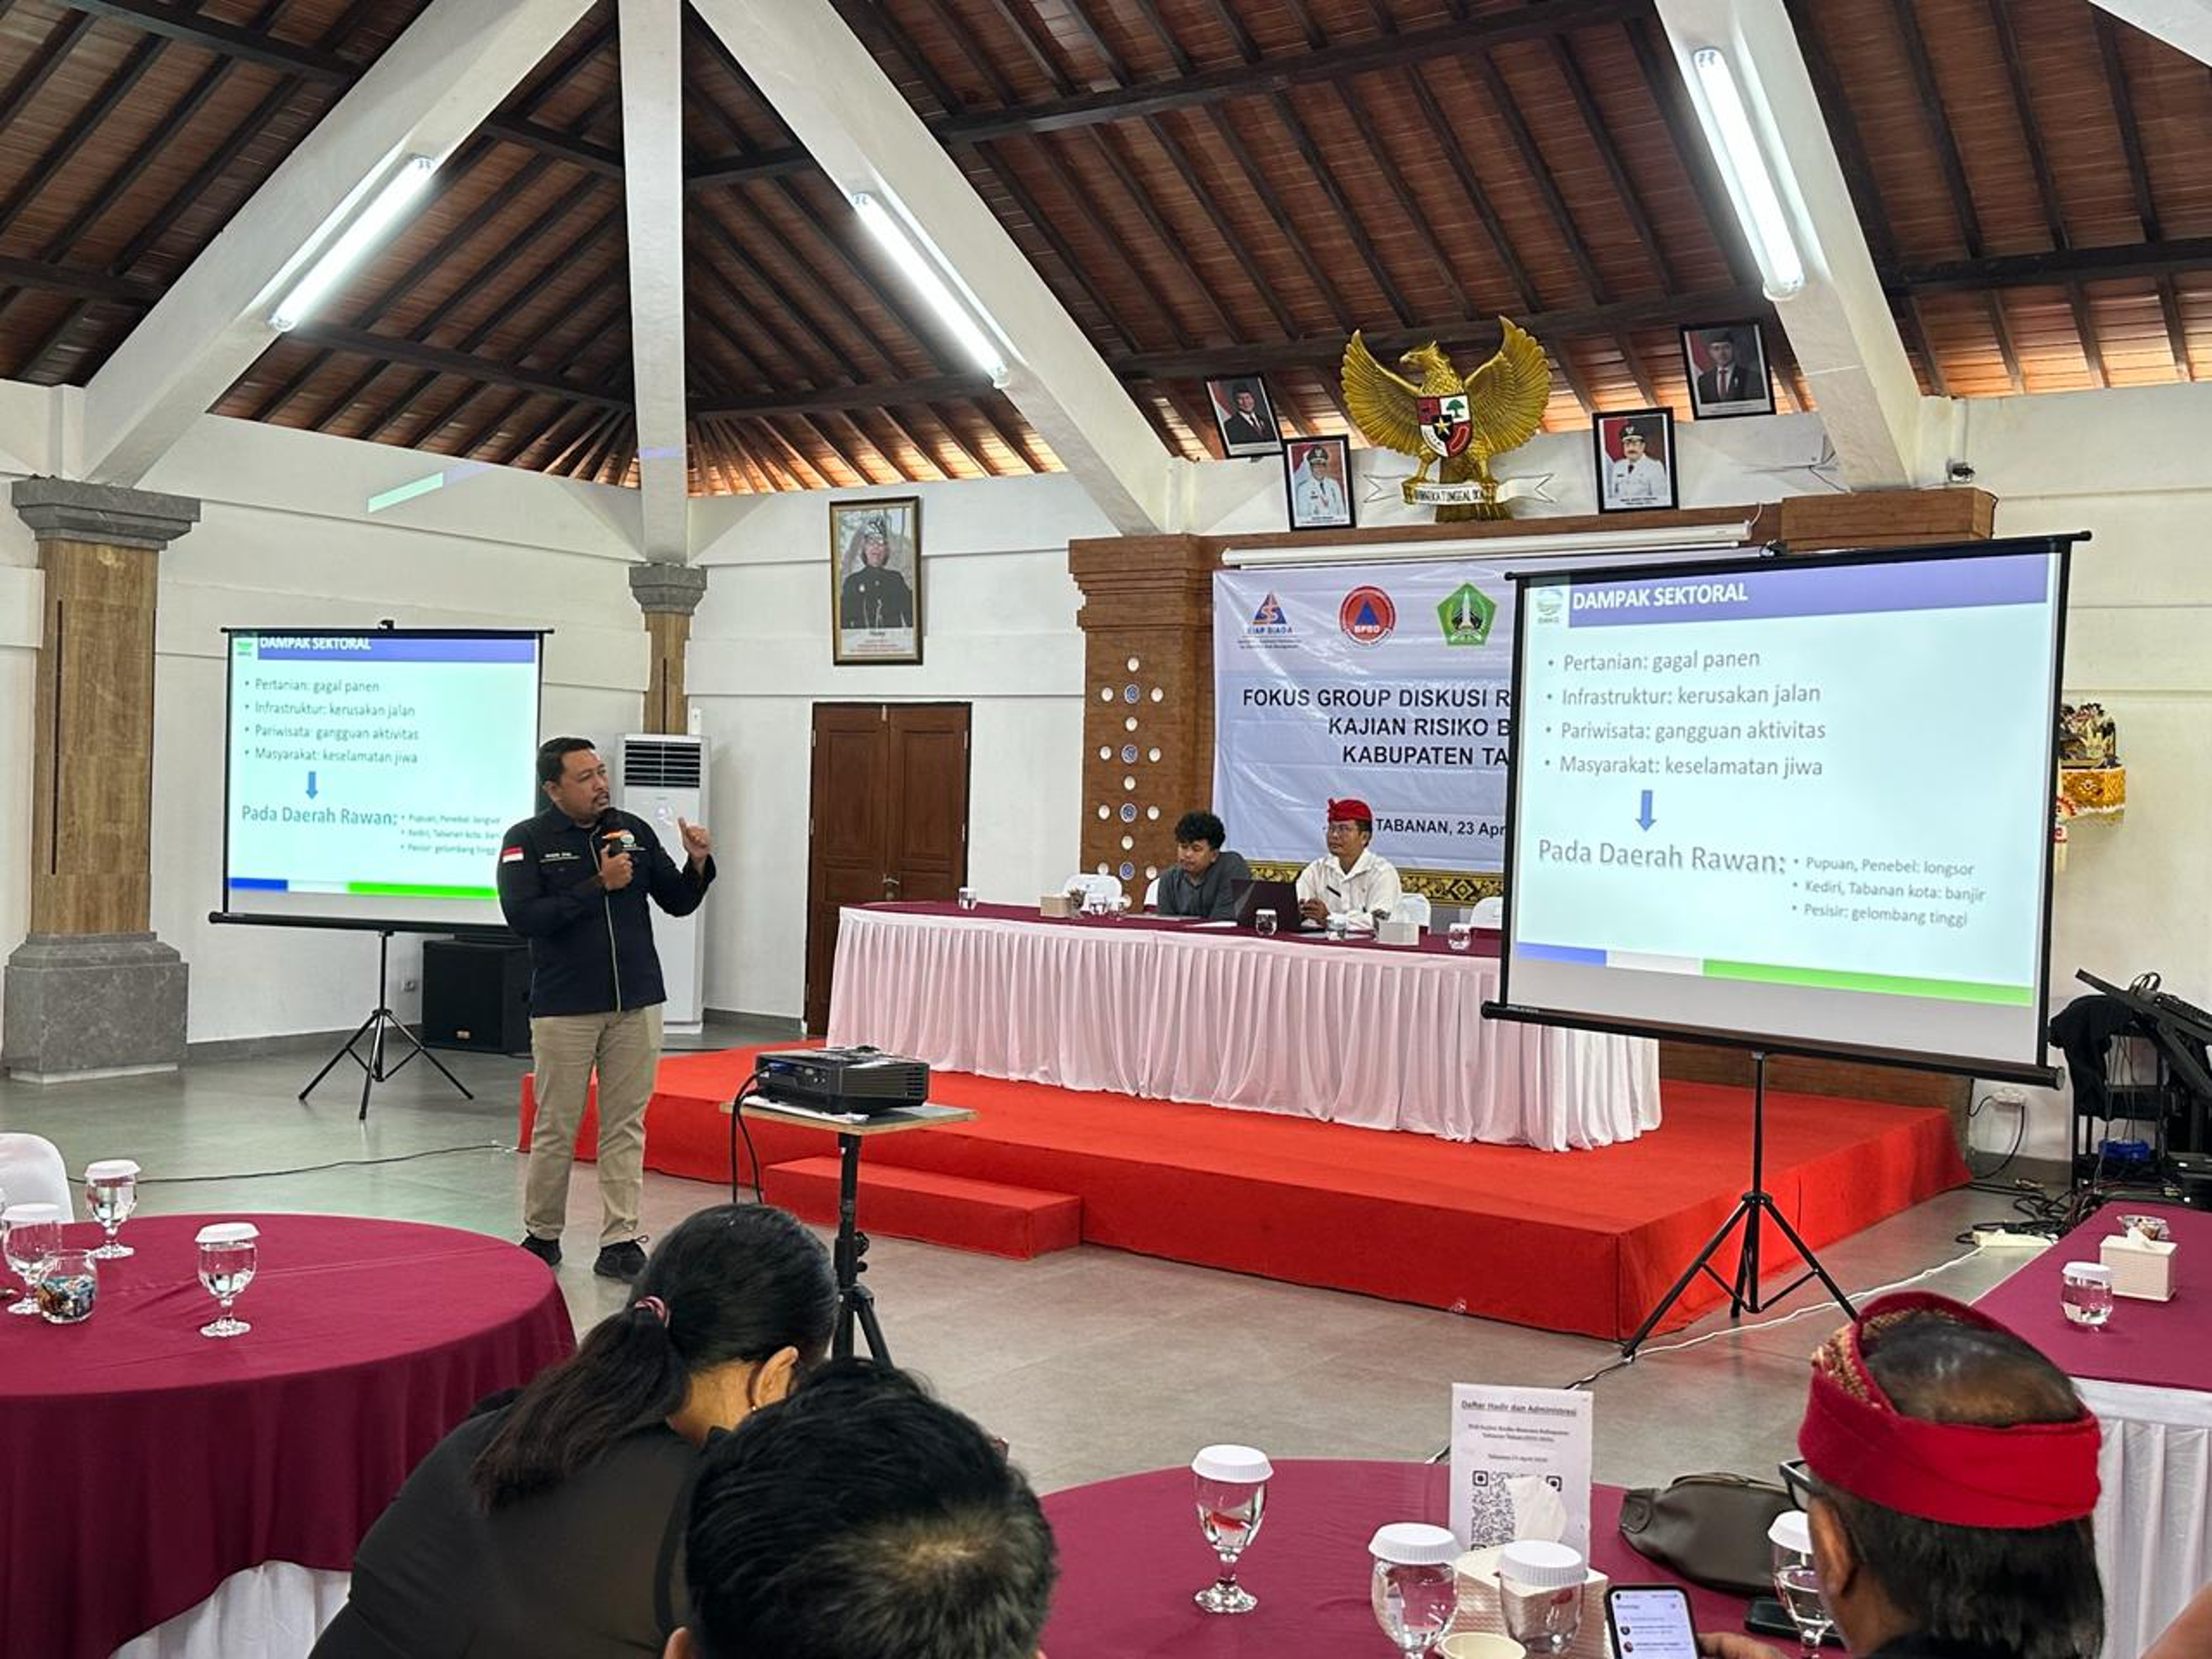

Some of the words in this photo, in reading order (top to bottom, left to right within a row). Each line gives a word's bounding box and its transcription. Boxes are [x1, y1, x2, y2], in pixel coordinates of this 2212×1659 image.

[1573, 586, 1649, 610] DAMPAK
[1653, 582, 1748, 605] SEKTORAL
[260, 637, 310, 650] DAMPAK
[312, 638, 371, 650] SEKTORAL
[1564, 653, 1648, 672] Pertanian:
[1652, 650, 1698, 673] gagal
[1703, 651, 1761, 672] panen
[313, 680, 342, 695] gagal
[344, 682, 380, 695] panen
[1243, 689, 1310, 707] FOKUS
[1318, 689, 1391, 707] GROUP
[1398, 689, 1487, 707] DISKUSI
[1561, 687, 1673, 705] Infrastruktur:
[1677, 685, 1769, 705] kerusakan
[1773, 684, 1820, 707] jalan
[329, 702, 385, 716] kerusakan
[387, 705, 416, 719] jalan
[315, 727, 369, 742] gangguan
[372, 727, 420, 741] aktivitas
[1328, 718, 1406, 736] KAJIAN
[1414, 720, 1489, 736] RISIKO
[1561, 722, 1651, 740] Pariwisata:
[1655, 724, 1741, 743] gangguan
[1747, 721, 1826, 740] aktivitas
[322, 749, 392, 763] keselamatan
[394, 751, 418, 766] jiwa
[1343, 746, 1474, 765] KABUPATEN
[1560, 756, 1660, 777] Masyarakat:
[1665, 756, 1778, 776] keselamatan
[1782, 757, 1823, 780] jiwa
[242, 805, 278, 822] Pada
[281, 807, 336, 824] Daerah
[1376, 818, 1452, 836] TABANAN,
[1457, 820, 1475, 834] 23
[1478, 821, 1506, 839] Apr
[1538, 838, 1592, 865] Pada
[1599, 841, 1684, 870] Daerah
[1691, 845, 1787, 875] Rawan:
[1805, 855, 1859, 873] Pupuan,
[1861, 858, 1922, 874] Penebel:
[1923, 861, 1975, 878] longsor
[1804, 879, 1846, 896] Kediri,
[1848, 882, 1905, 898] Tabanan
[1907, 885, 1943, 900] kota:
[1945, 886, 1986, 903] banjir
[1803, 903, 1850, 918] Pesisir:
[1851, 905, 1927, 925] gelombang
[1929, 909, 1968, 928] tinggi
